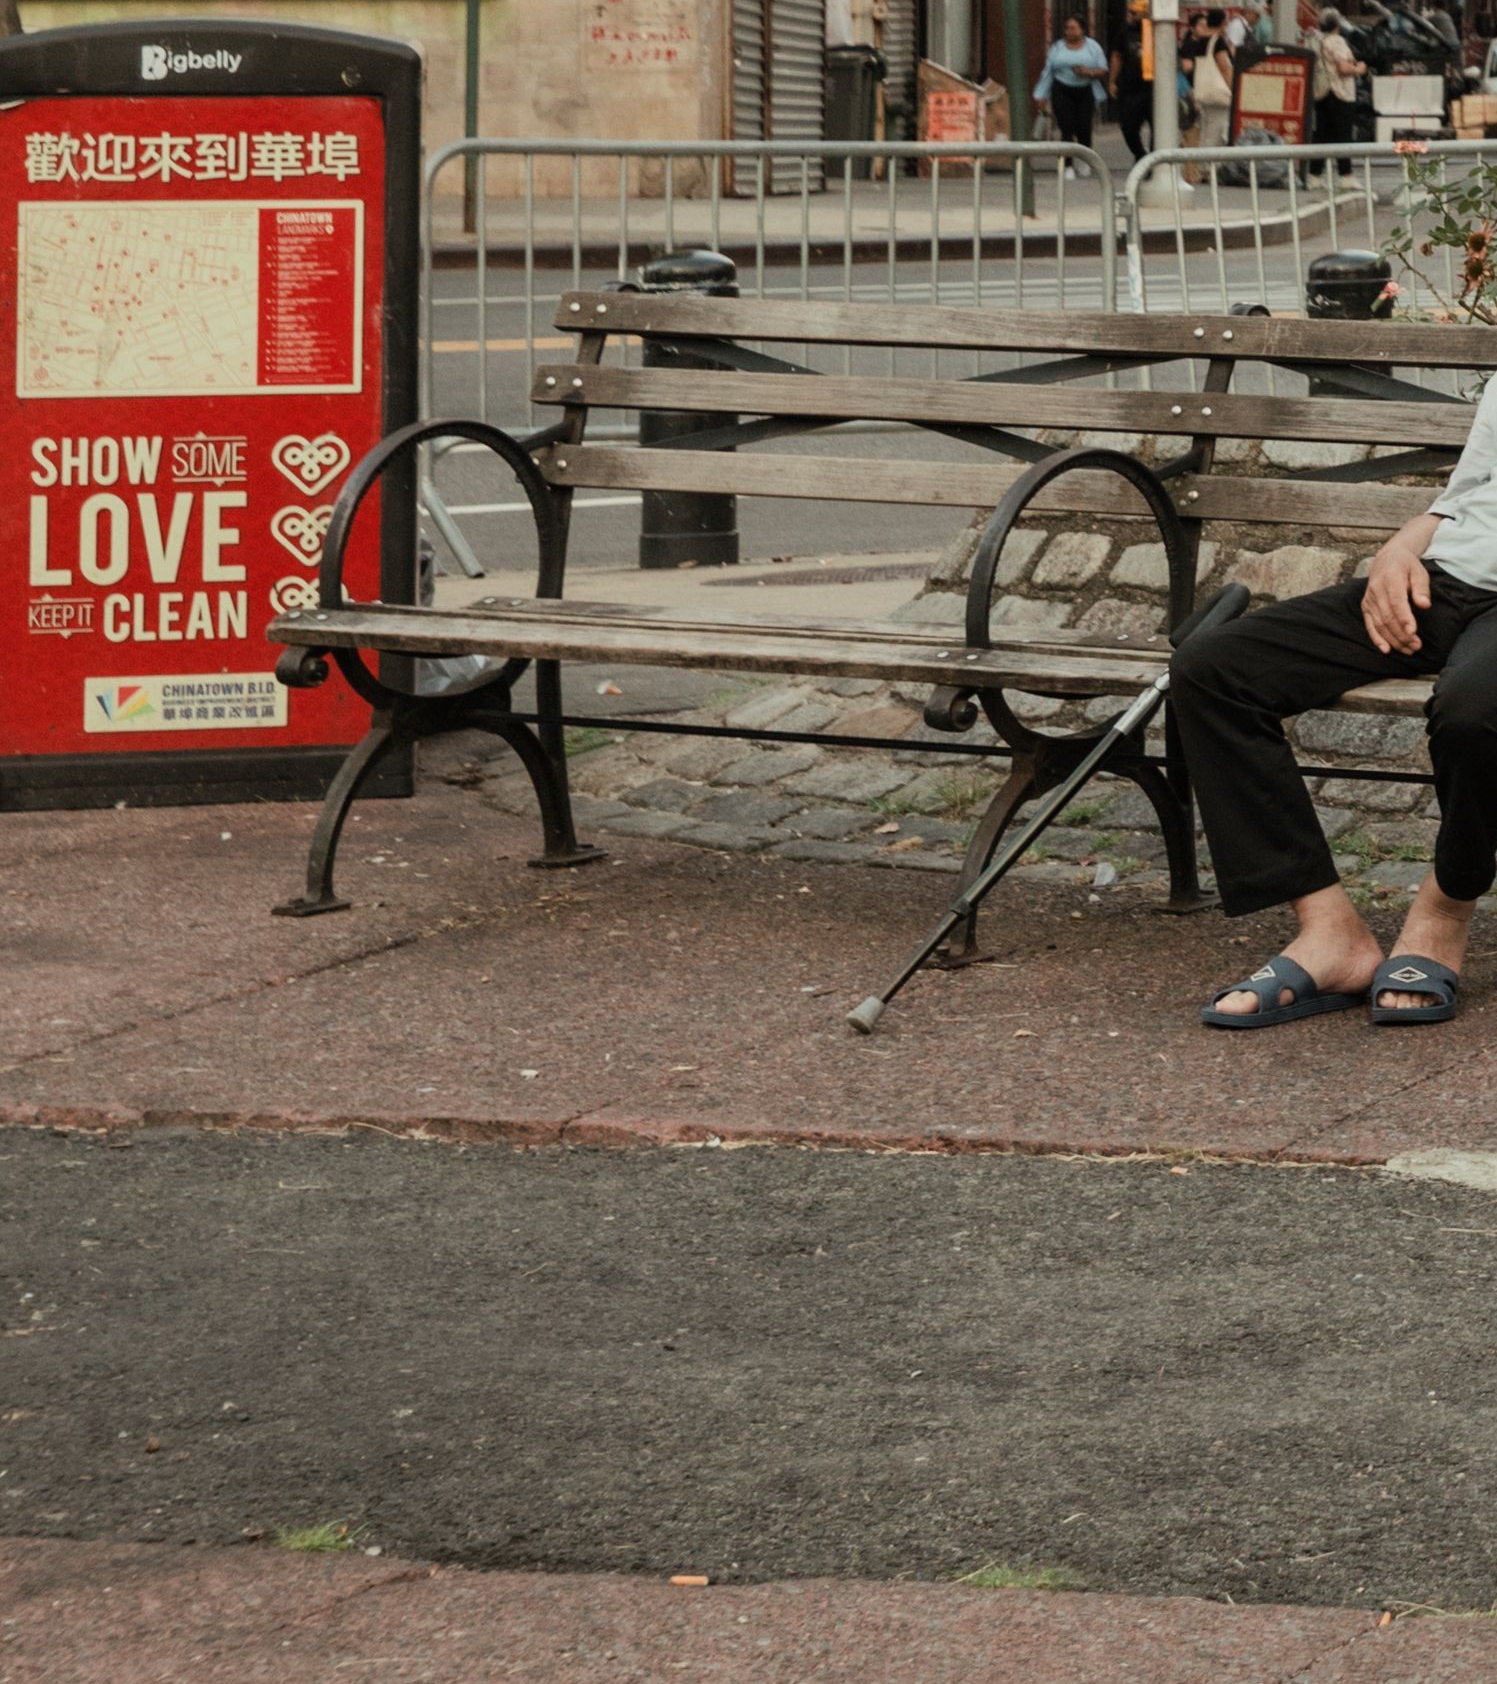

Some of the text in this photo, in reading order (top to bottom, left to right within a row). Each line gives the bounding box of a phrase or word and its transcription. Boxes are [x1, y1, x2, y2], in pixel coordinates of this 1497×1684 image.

[140, 43, 243, 81] Bigbelly
[23, 131, 362, 184] 歡迎來到華埠
[30, 434, 248, 487] SHOW SOME
[28, 490, 249, 588] LOVE
[27, 602, 94, 630] KEEP IT
[103, 591, 249, 643] CLEAN
[162, 682, 244, 698] CHINATOWN
